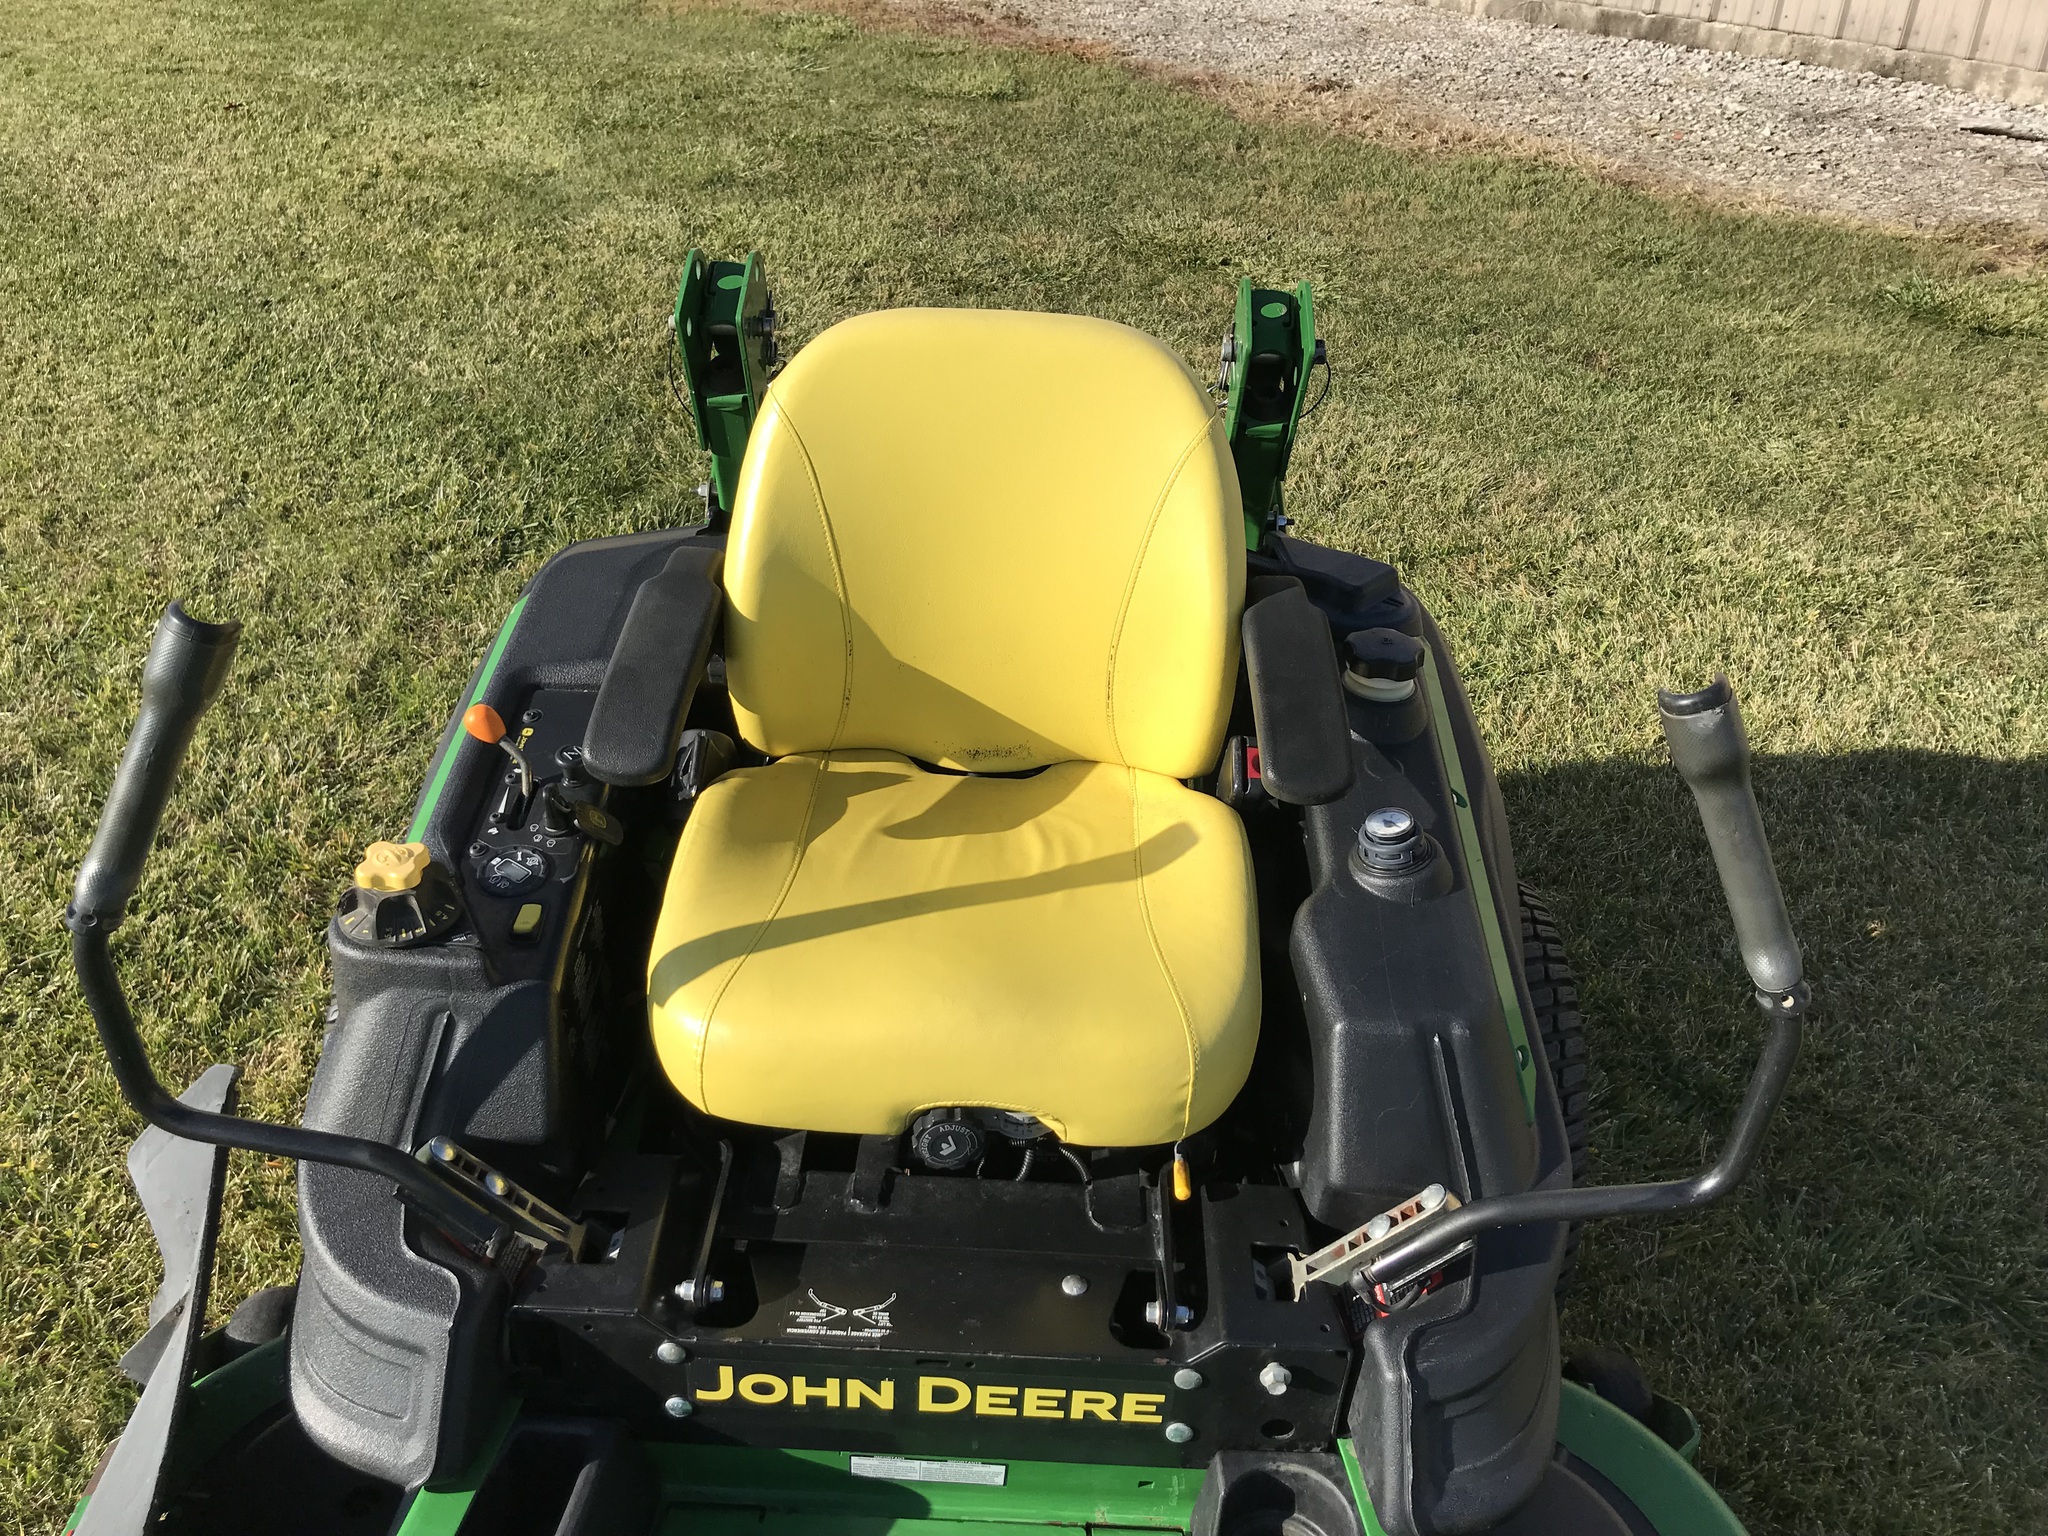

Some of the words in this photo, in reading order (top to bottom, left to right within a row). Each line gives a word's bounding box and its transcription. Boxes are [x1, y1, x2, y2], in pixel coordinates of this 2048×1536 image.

[939, 1124, 970, 1135] ADJUST
[695, 1365, 894, 1410] JOHN
[918, 1376, 1166, 1423] DEERE
